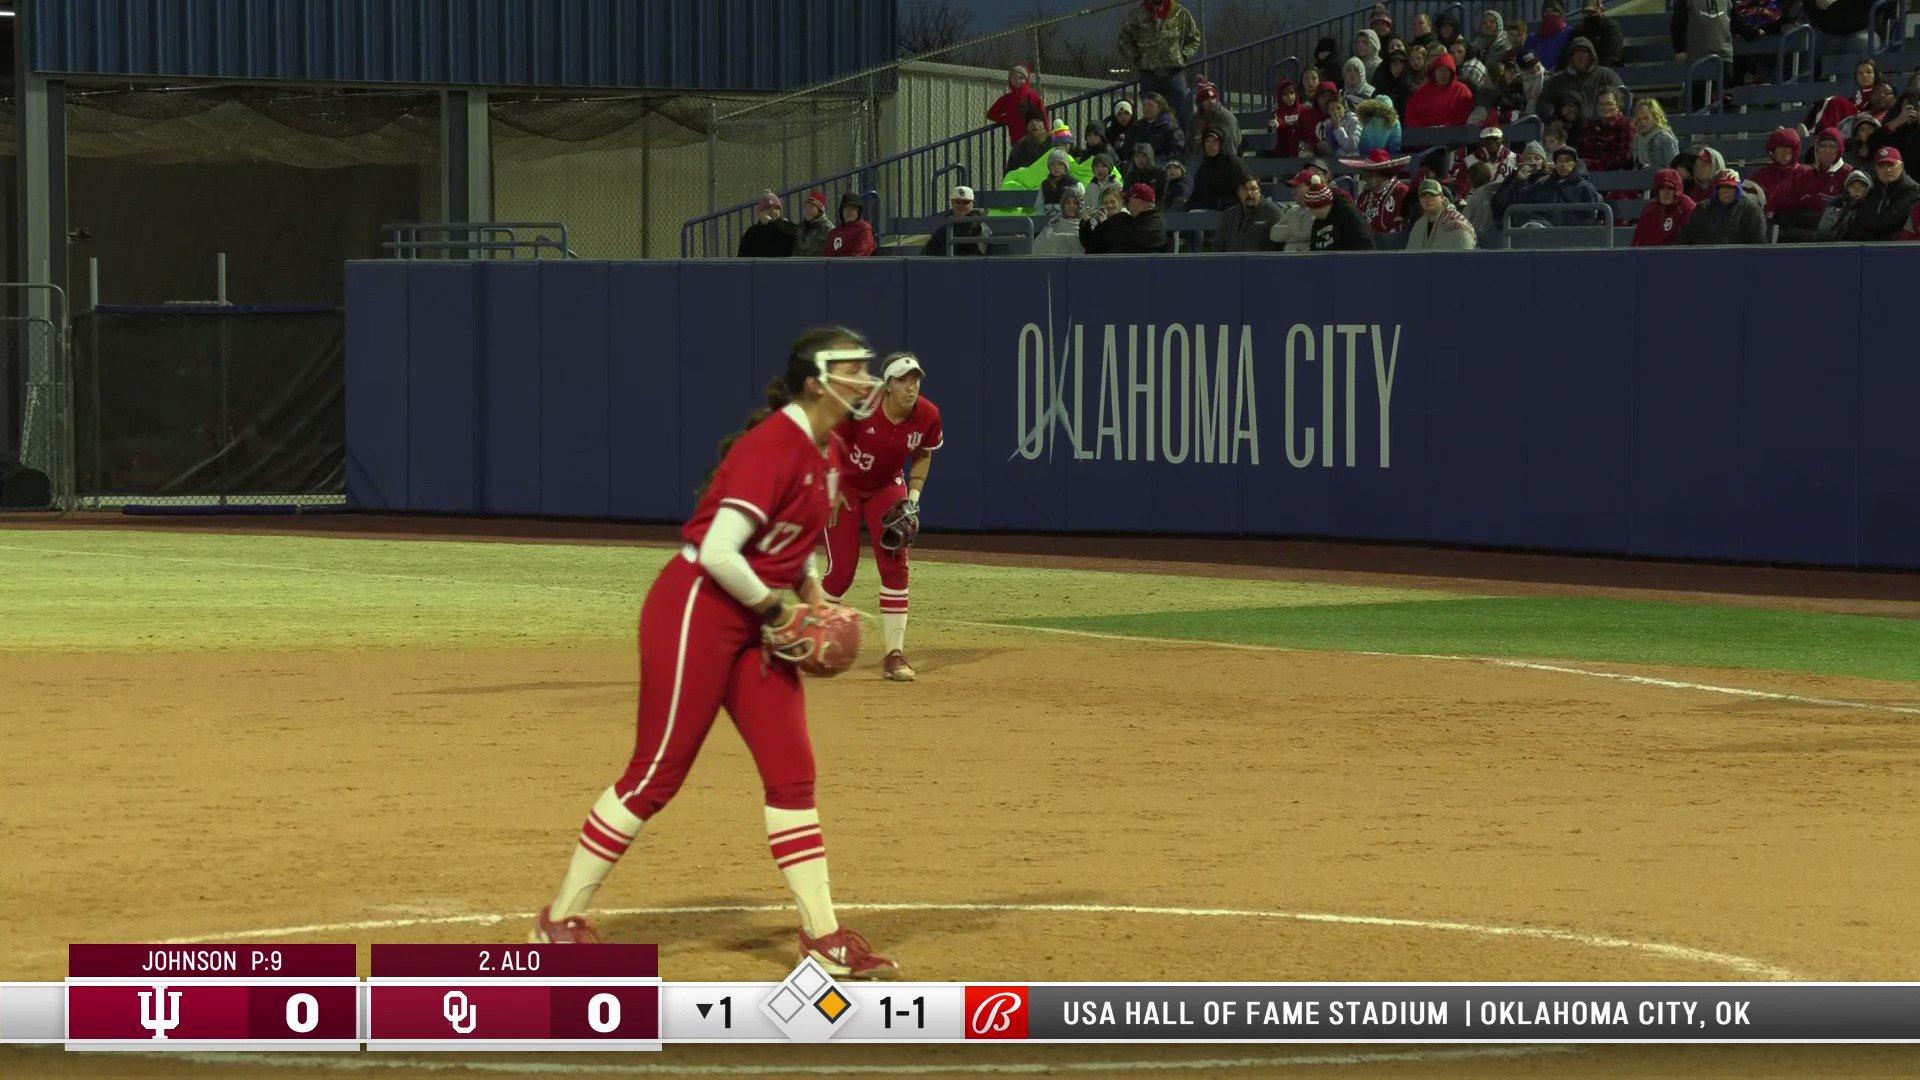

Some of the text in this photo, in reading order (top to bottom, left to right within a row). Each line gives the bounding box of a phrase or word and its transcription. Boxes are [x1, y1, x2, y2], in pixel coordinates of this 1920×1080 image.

[1009, 276, 1402, 468] OKLAHOMA CITY
[849, 444, 875, 471] 33
[756, 521, 802, 555] 17
